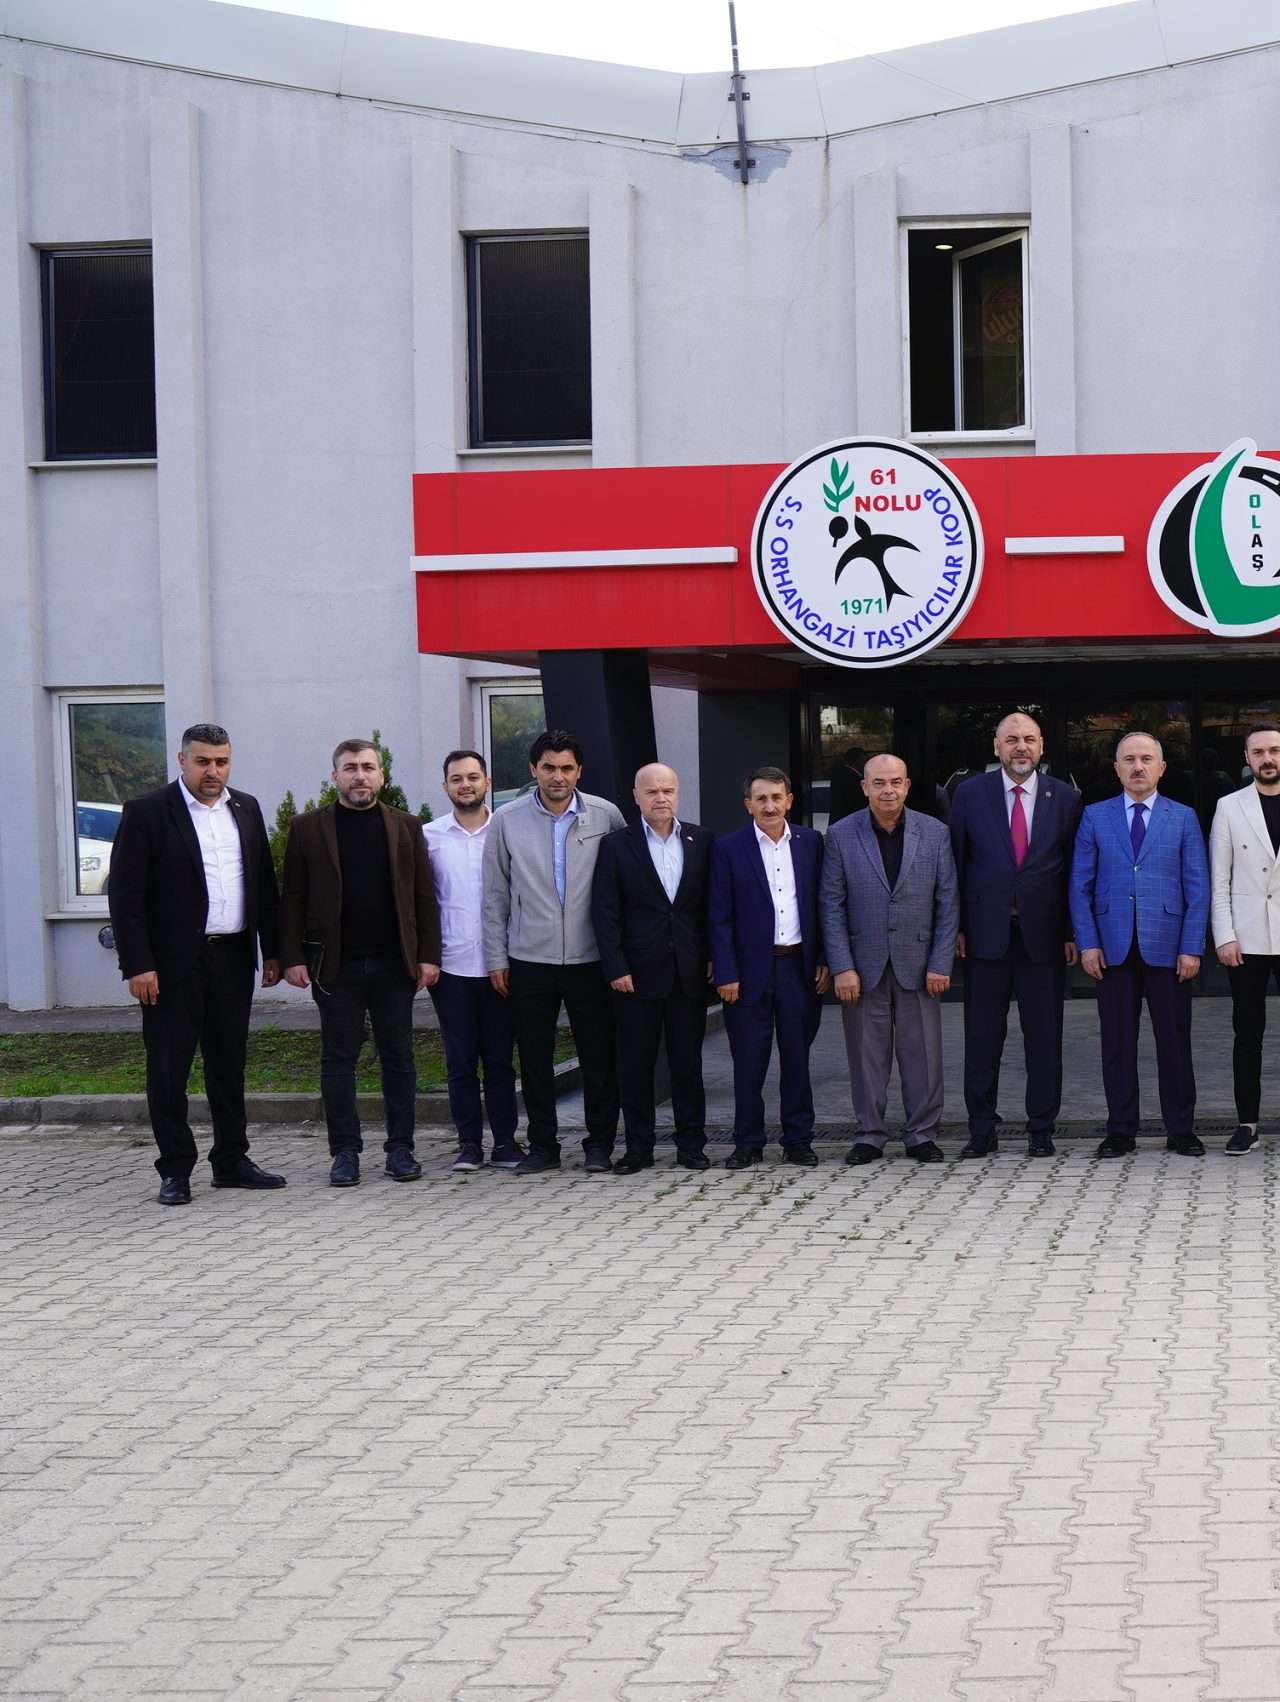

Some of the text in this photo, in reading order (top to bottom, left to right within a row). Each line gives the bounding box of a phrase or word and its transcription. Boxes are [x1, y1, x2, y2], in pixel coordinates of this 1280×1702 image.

[870, 468, 896, 485] 61
[855, 494, 922, 513] NOLU
[770, 536, 856, 649] ORHANGAZİ
[862, 554, 964, 650] TAŞIYICILAR
[923, 487, 964, 547] KOOP
[840, 597, 884, 616] 1971
